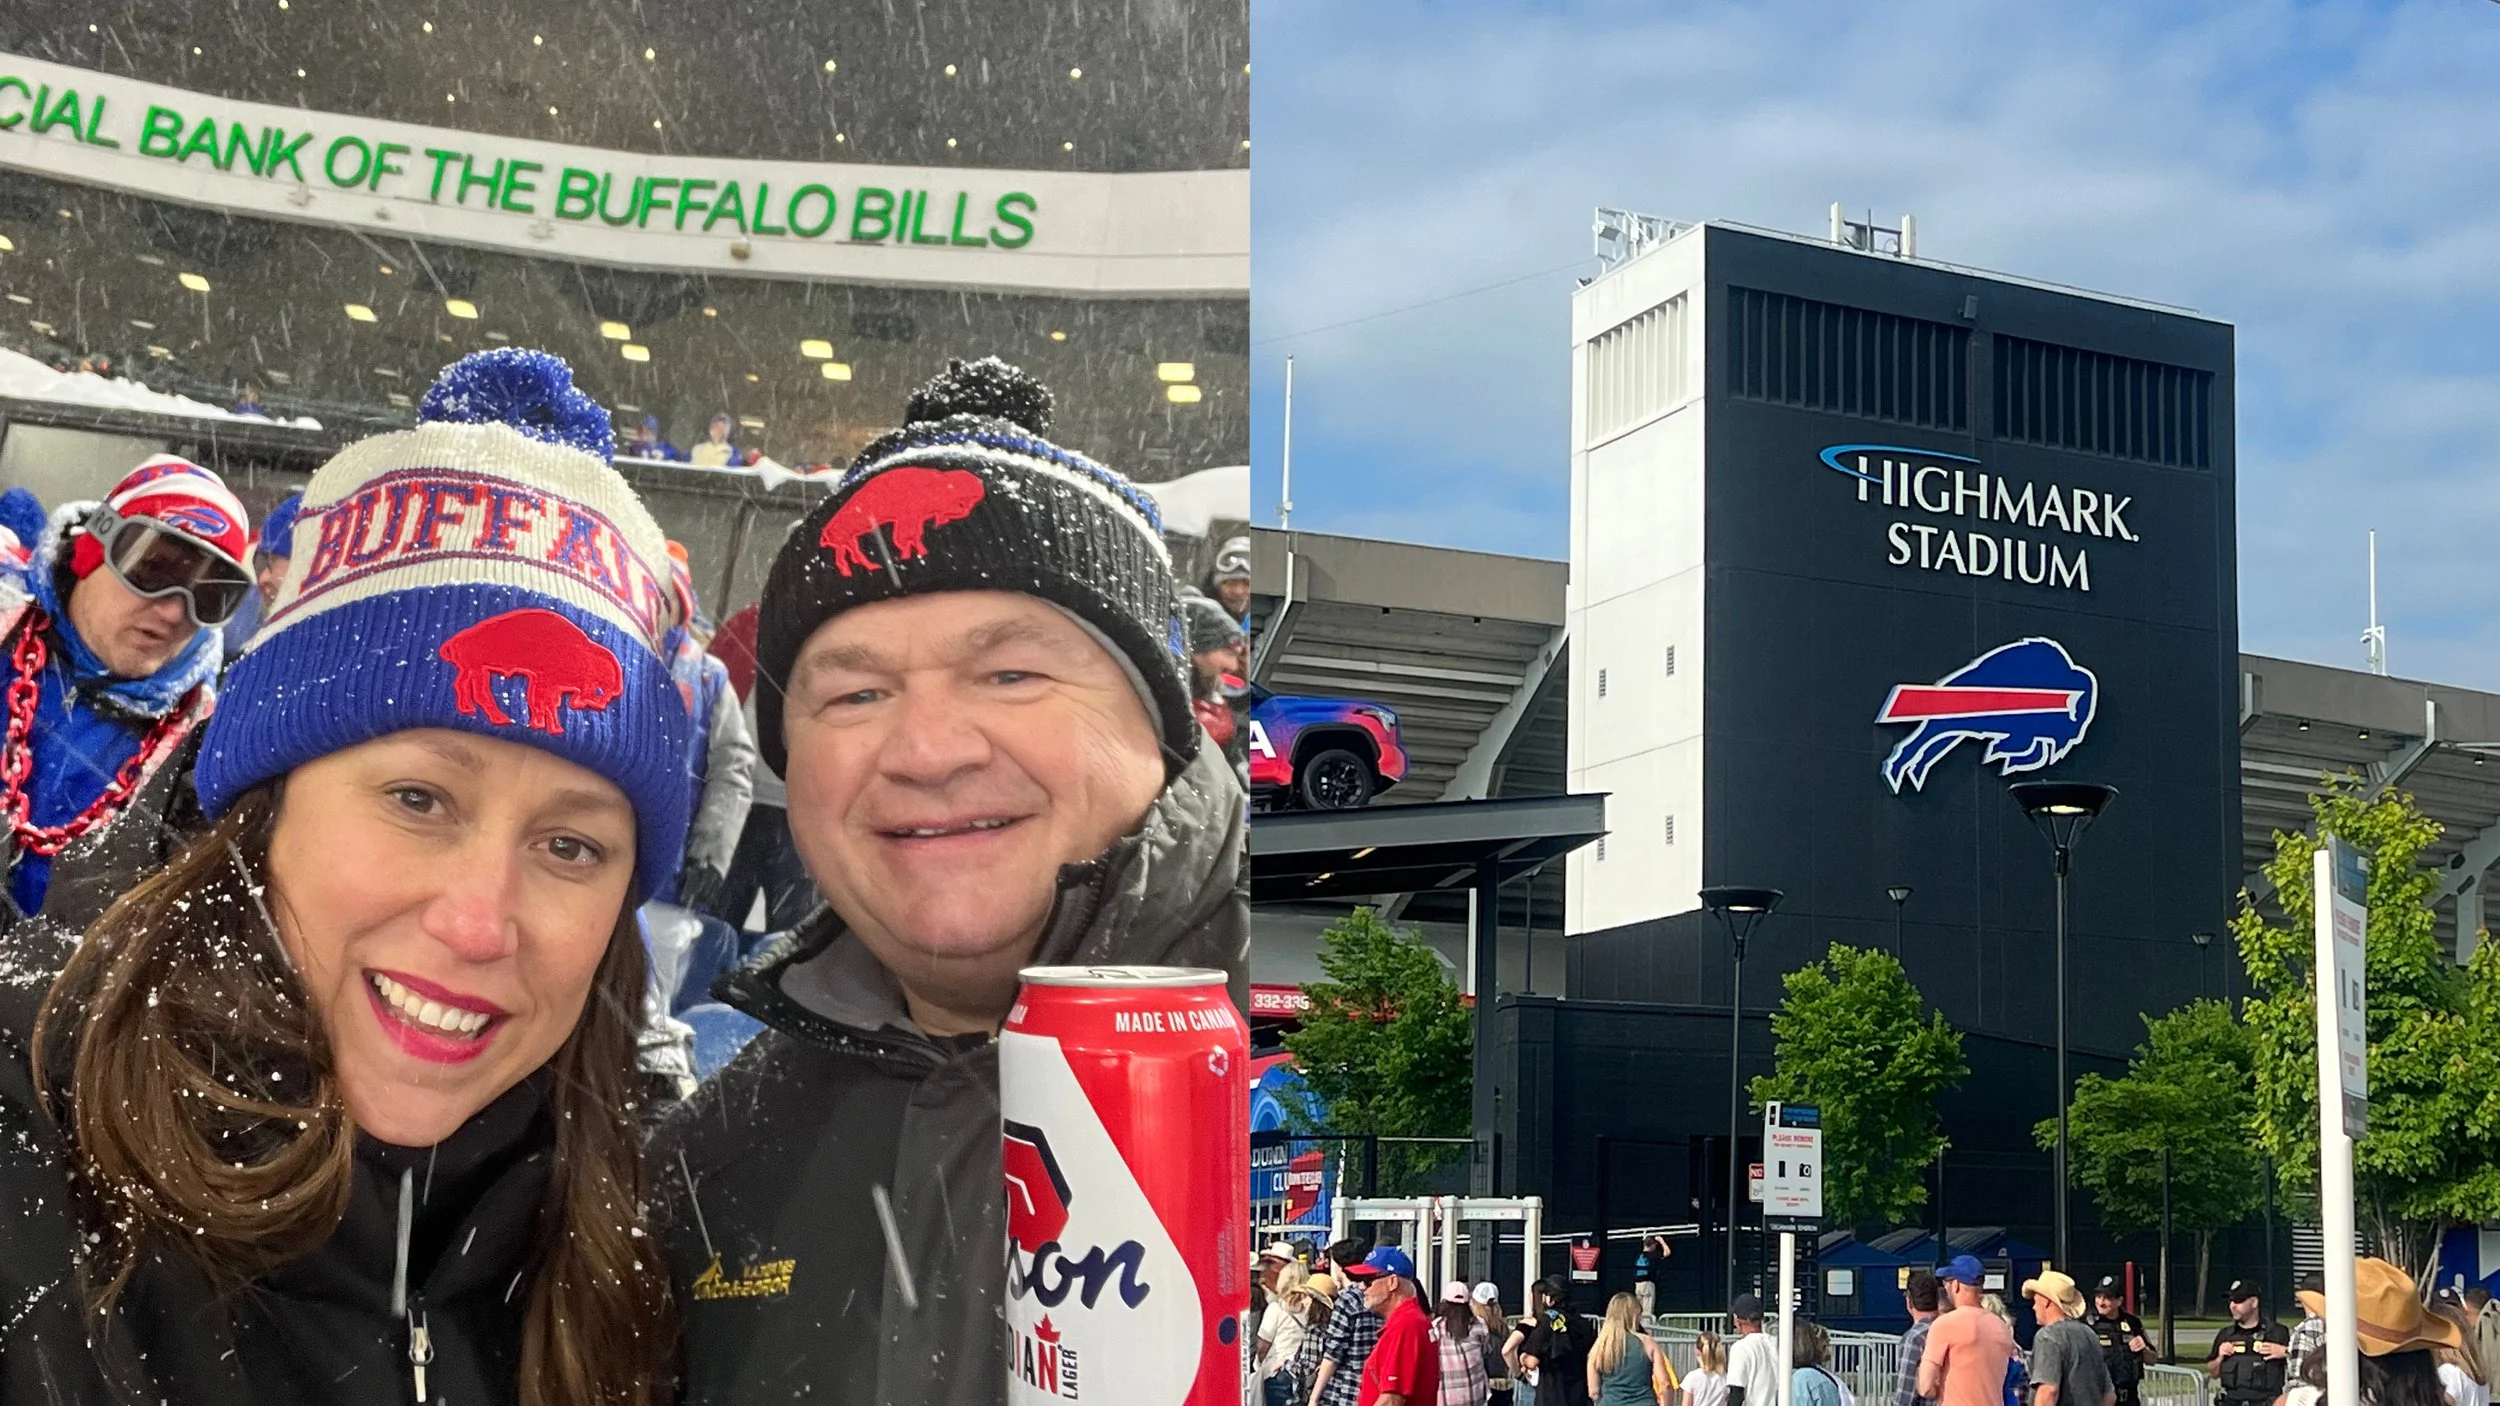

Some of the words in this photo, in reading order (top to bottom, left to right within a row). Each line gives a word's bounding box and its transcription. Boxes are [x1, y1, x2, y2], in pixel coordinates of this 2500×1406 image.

[138, 104, 314, 184] BANK
[324, 135, 411, 192] OF
[423, 148, 544, 214] THE
[554, 166, 838, 238] BUFFALO
[849, 187, 1039, 249] BILLS
[1887, 521, 2091, 592] STADIUM
[1115, 1011, 1166, 1033] MADE
[1167, 1010, 1189, 1033] IN
[1062, 1347, 1080, 1401] LAGER
